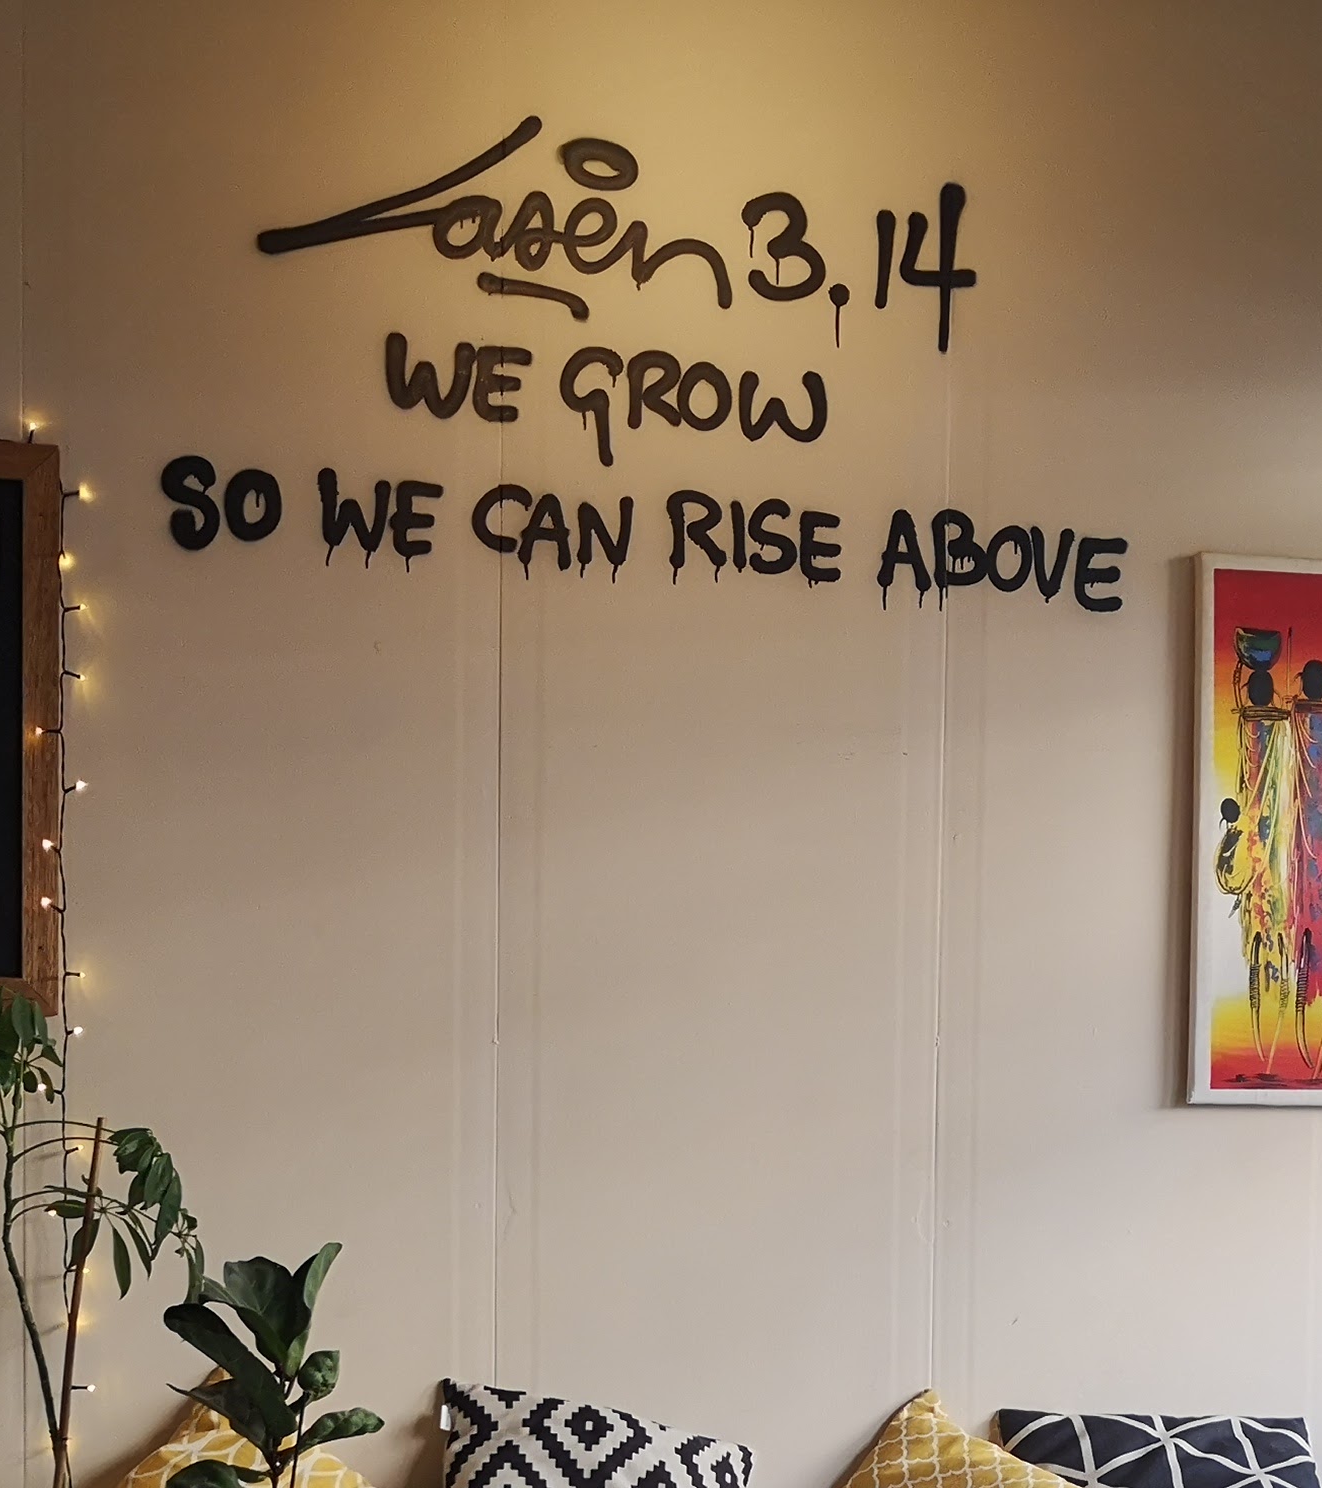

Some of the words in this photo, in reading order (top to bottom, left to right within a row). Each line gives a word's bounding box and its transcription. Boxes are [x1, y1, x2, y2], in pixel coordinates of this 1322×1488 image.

[385, 333, 533, 424] WE
[558, 346, 829, 467] GROW
[160, 453, 282, 552] SO
[317, 467, 445, 573] WE
[472, 482, 633, 583] CAN
[666, 489, 842, 588] RISE
[876, 509, 1130, 612] ABOVE
